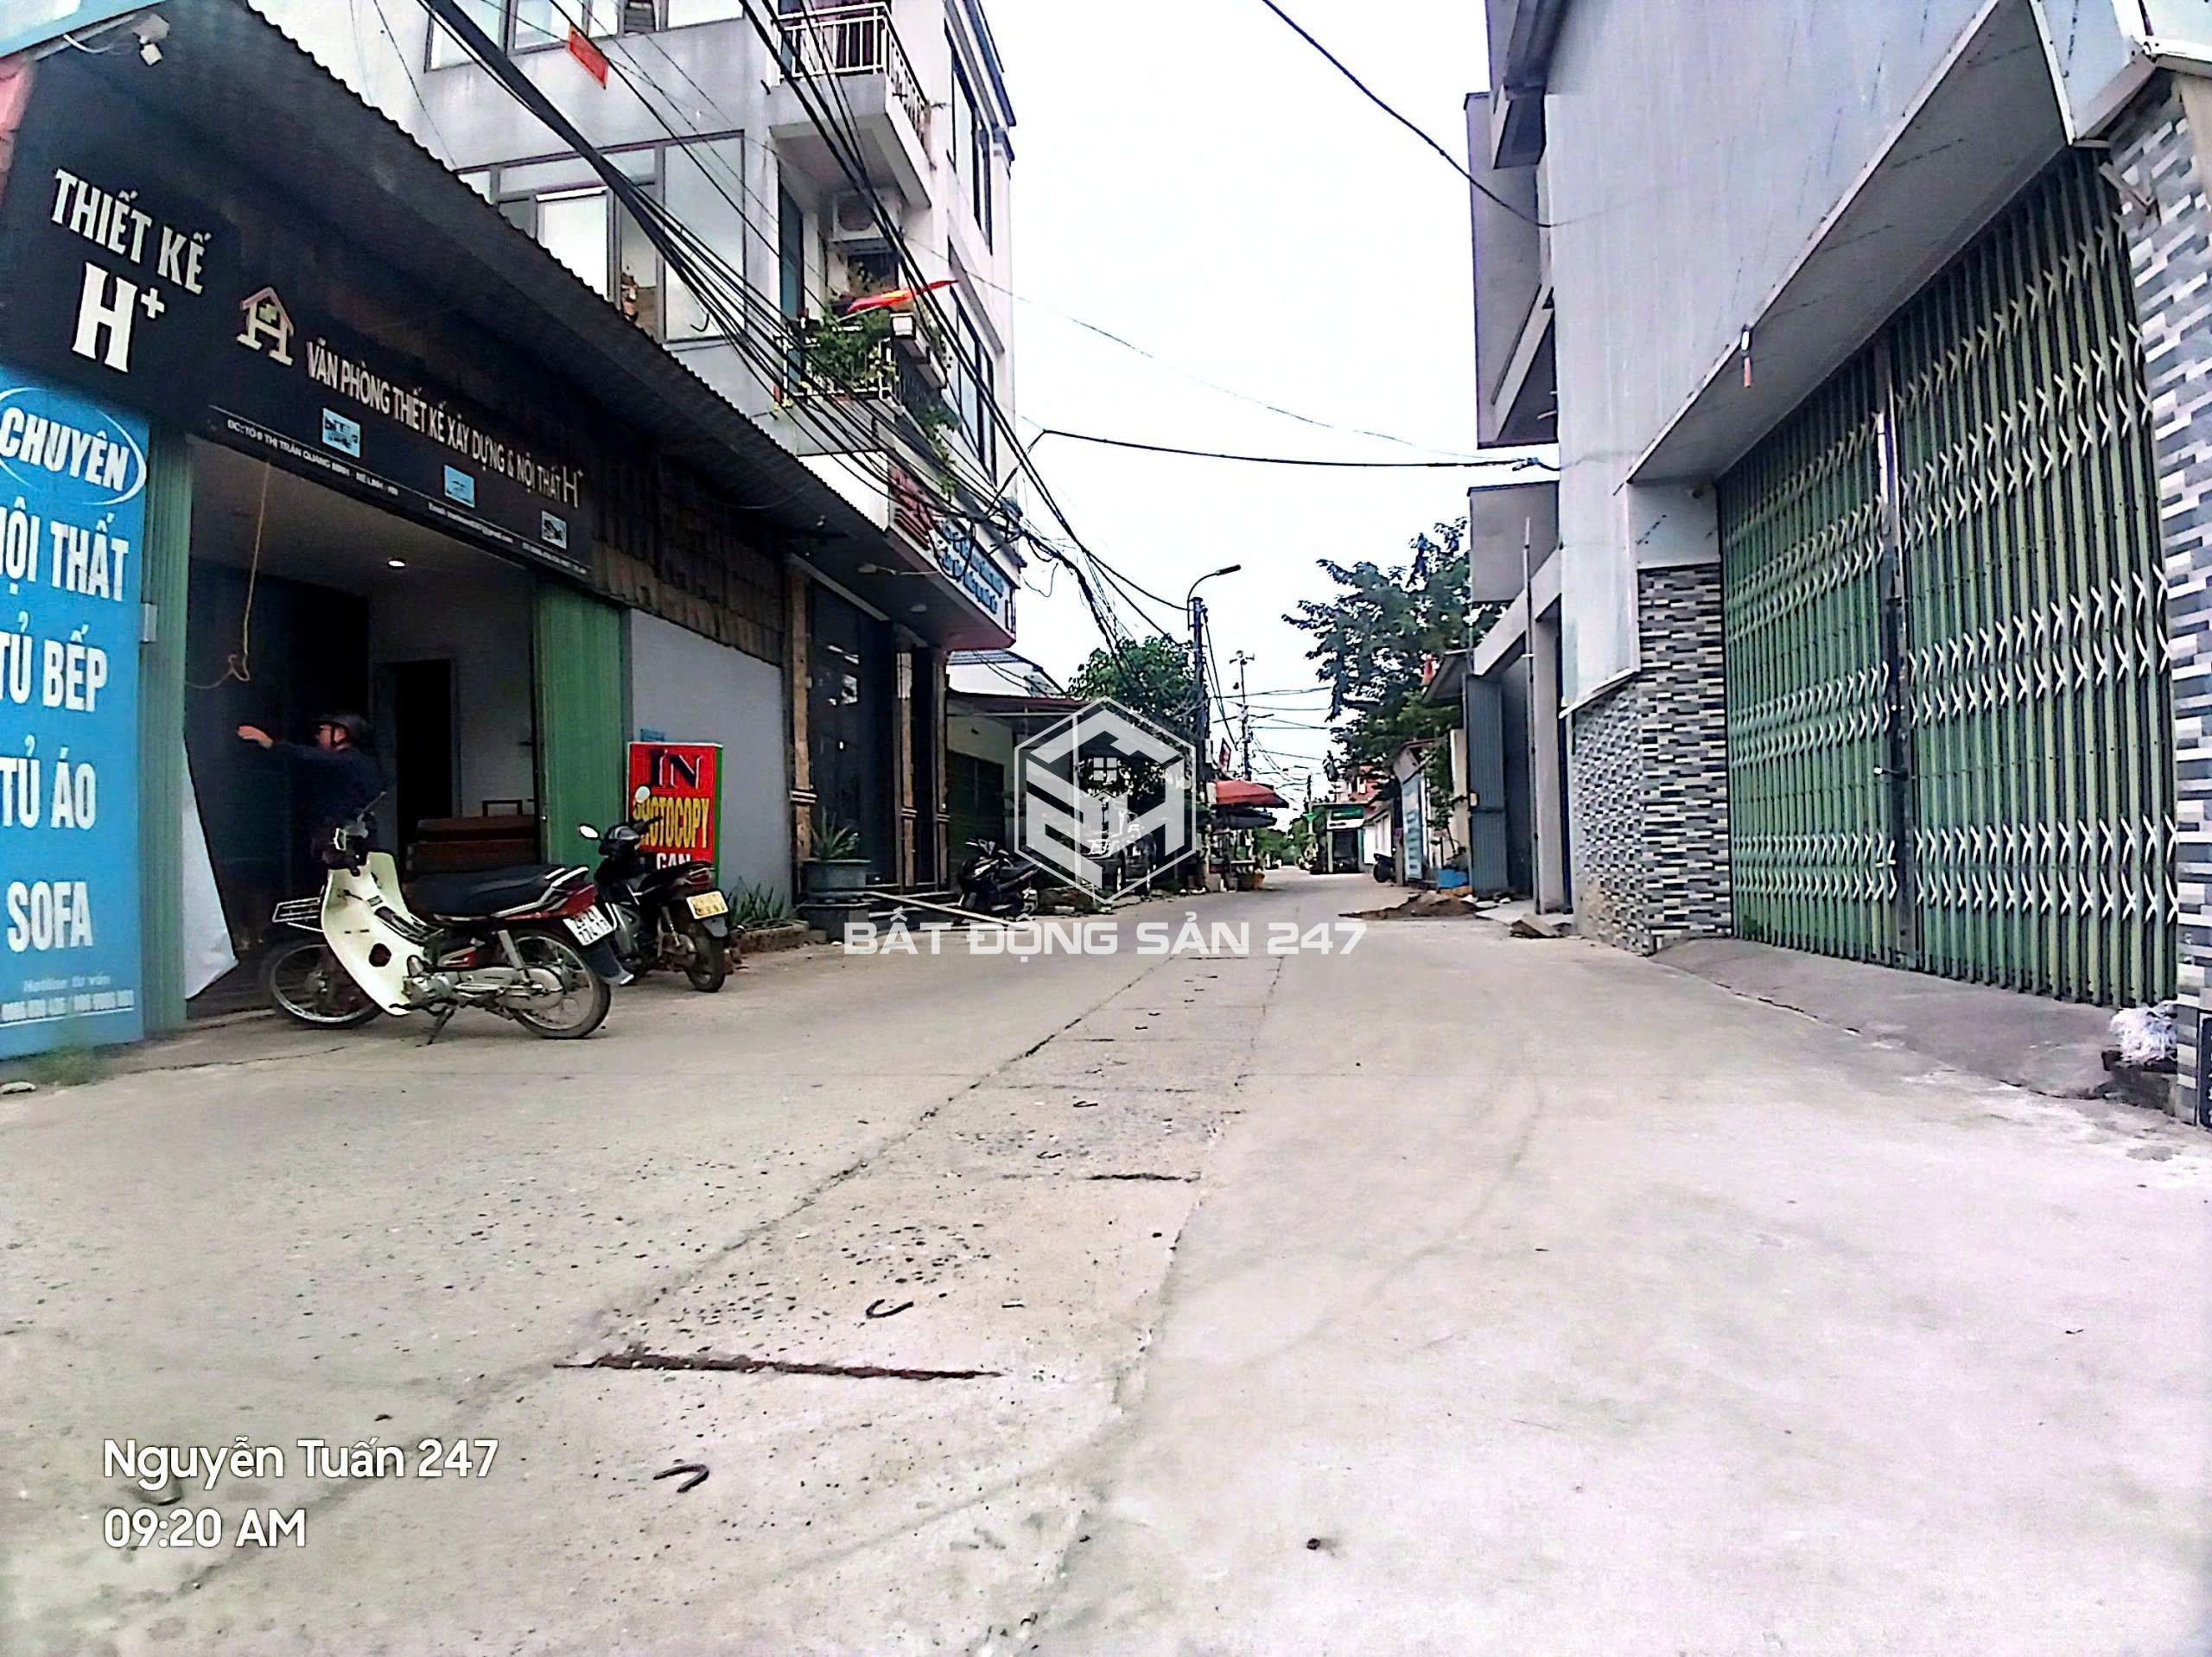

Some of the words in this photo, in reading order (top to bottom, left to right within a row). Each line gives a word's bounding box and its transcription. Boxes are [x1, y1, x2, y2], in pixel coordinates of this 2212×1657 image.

[51, 168, 153, 264] THIẾT
[156, 226, 212, 295] KẾ
[1, 406, 130, 492] CHUYÊN
[306, 337, 338, 389] VĂN
[340, 361, 390, 414] PHÒNG
[392, 387, 427, 433] THIẾT
[429, 401, 447, 442] KẾ
[448, 413, 469, 454] XÂY
[473, 430, 505, 473] DỰNG
[517, 452, 536, 493] NỘI
[537, 466, 561, 501] THẤT
[51, 512, 129, 601] THẤT
[43, 625, 107, 712] BẾP
[0, 734, 40, 828] TỦ
[51, 747, 96, 829] ÁO
[649, 749, 702, 790] IN
[7, 881, 93, 952] SOFA
